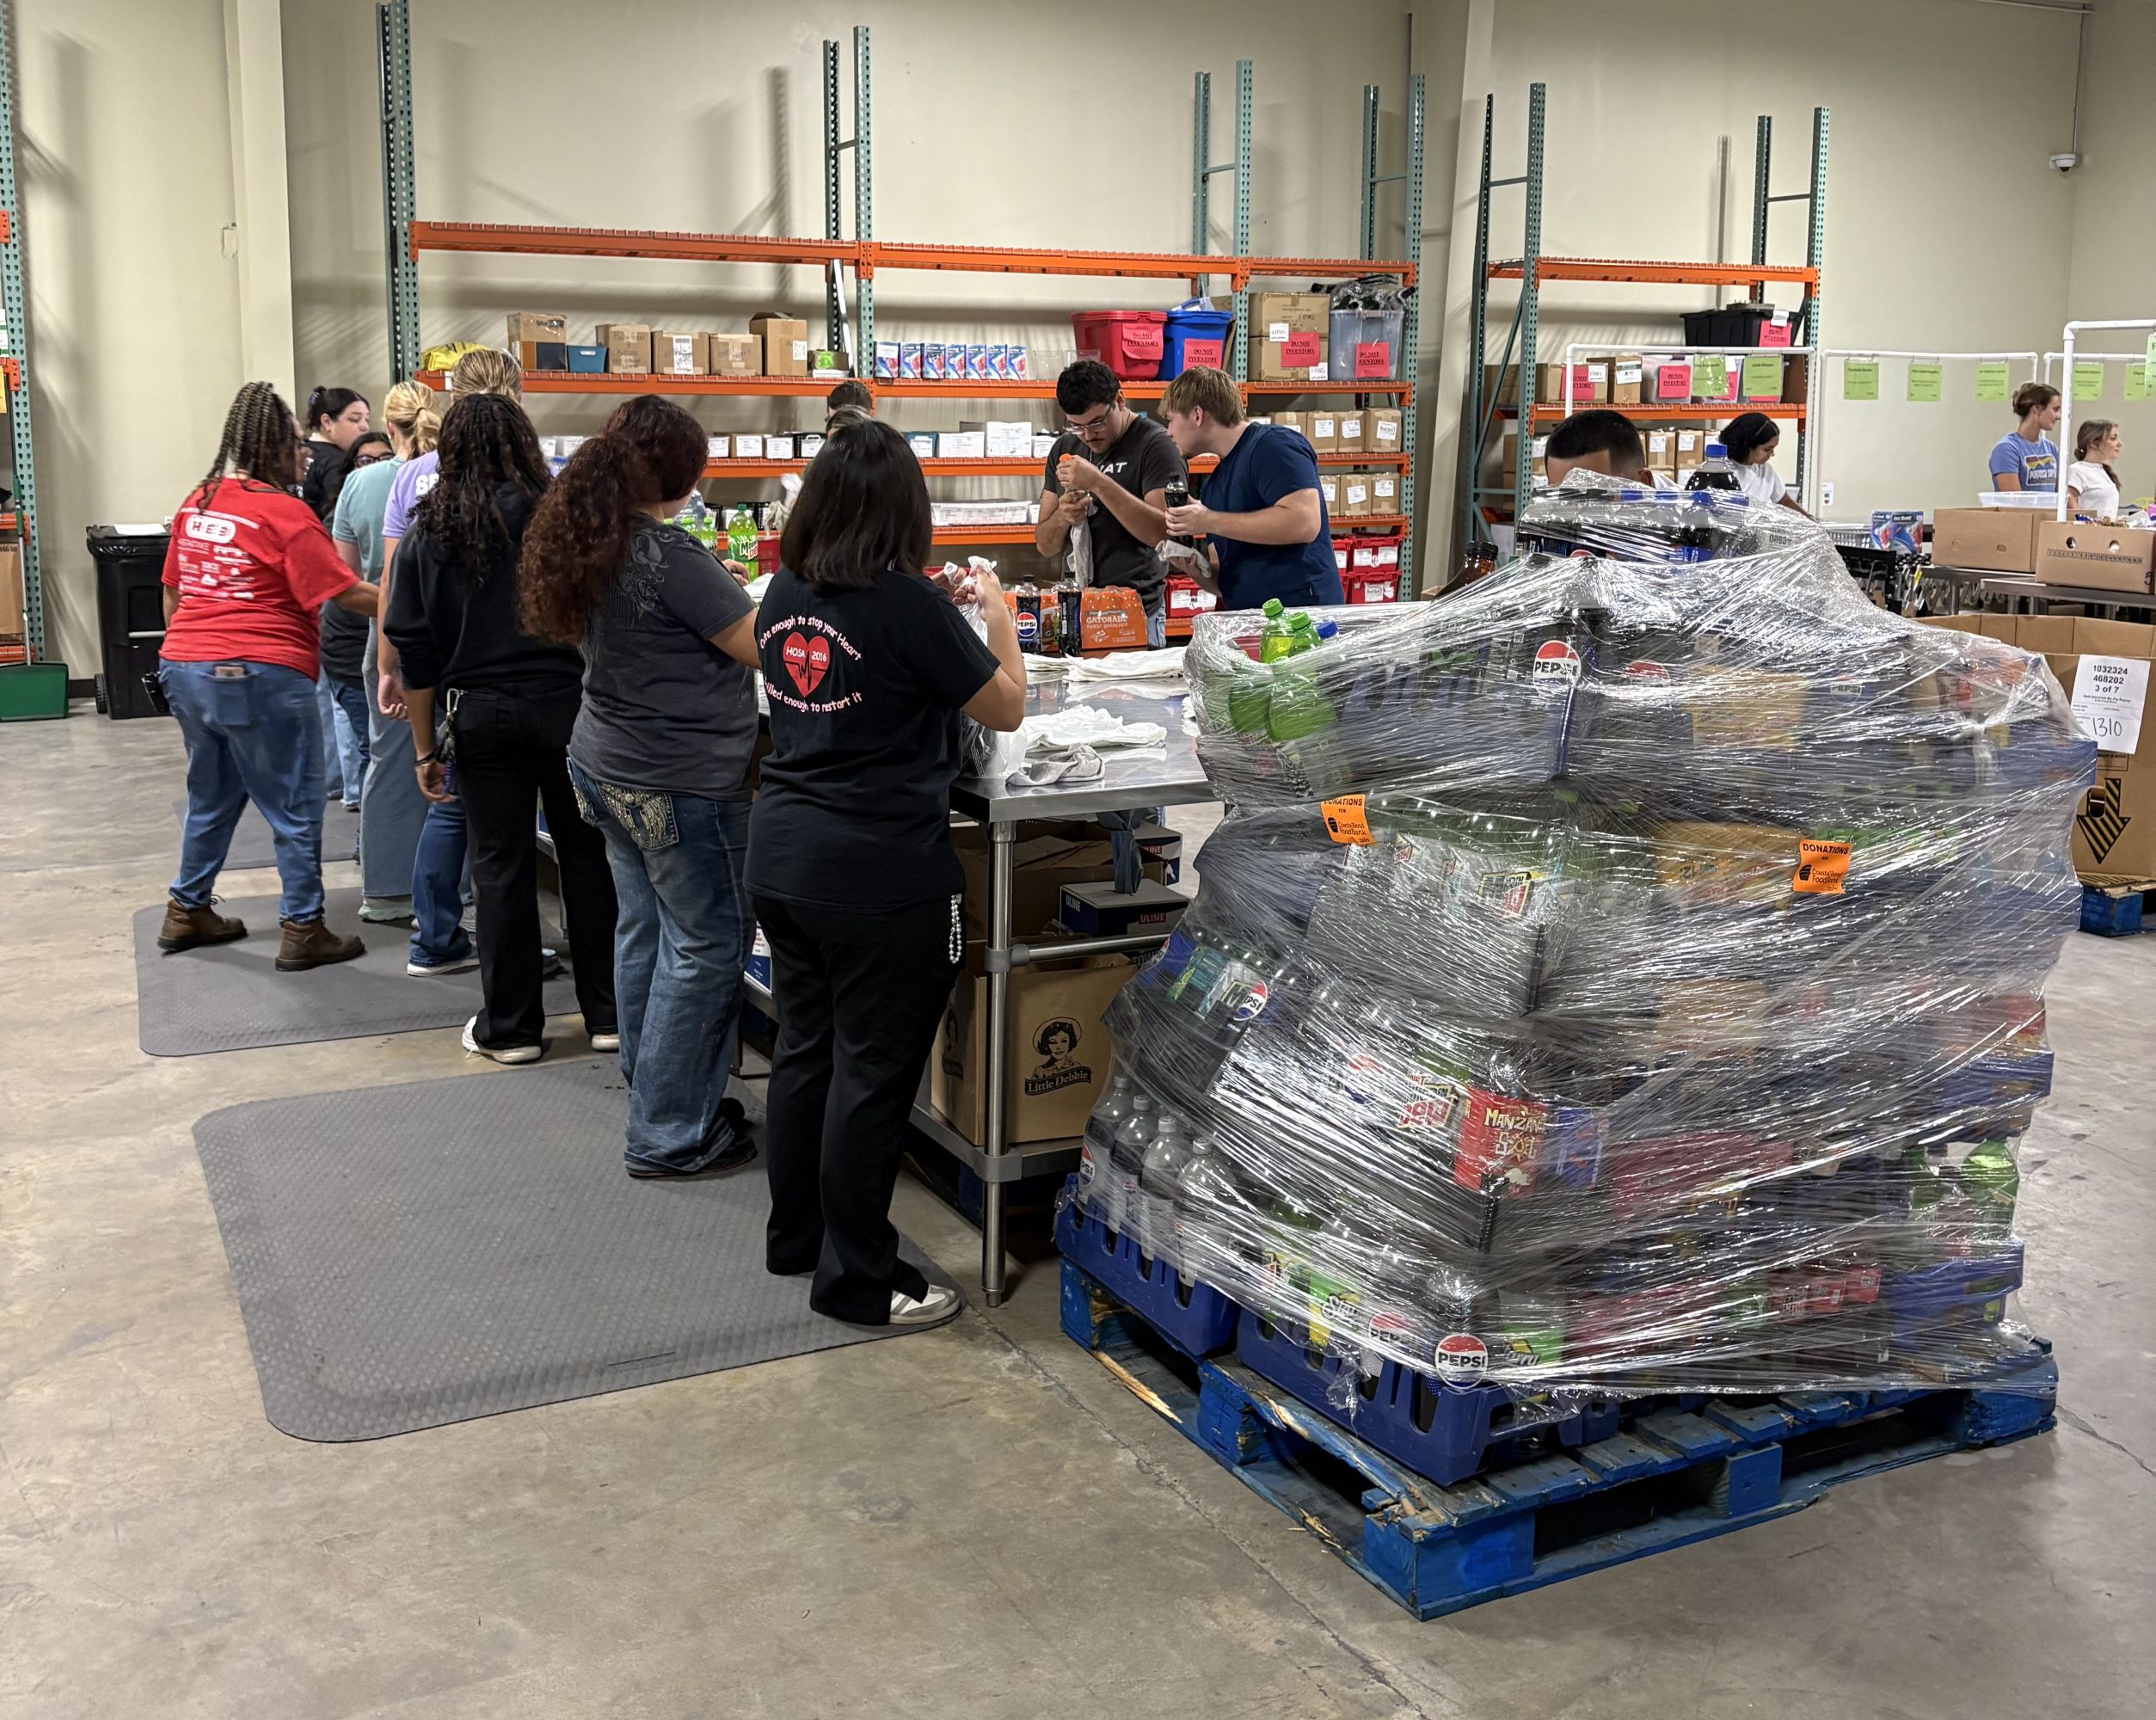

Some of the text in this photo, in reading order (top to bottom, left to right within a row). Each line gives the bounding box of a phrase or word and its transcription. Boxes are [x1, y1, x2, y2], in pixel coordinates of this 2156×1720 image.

[771, 615, 795, 634] enough
[797, 615, 806, 625] to
[808, 616, 823, 630] stop
[823, 622, 838, 637] your
[837, 633, 862, 660] Heart
[786, 646, 826, 661] HOSA 2016
[1534, 661, 1578, 677] PEPSI
[2093, 665, 2128, 675] 1032324
[2093, 675, 2124, 684] 468202
[1832, 685, 1862, 694] PEPSI
[783, 695, 808, 713] enough
[810, 702, 820, 712] to
[822, 697, 851, 712] restart
[852, 691, 862, 703] it
[2092, 717, 2122, 736] 1310
[1803, 844, 1849, 854] DONATIONS
[1066, 894, 1081, 912] ULINE
[1140, 913, 1164, 923] ULINE
[1028, 1072, 1089, 1093] Little Debbie
[1496, 1131, 1537, 1159] SOL
[1438, 1352, 1486, 1367] PEPSI
